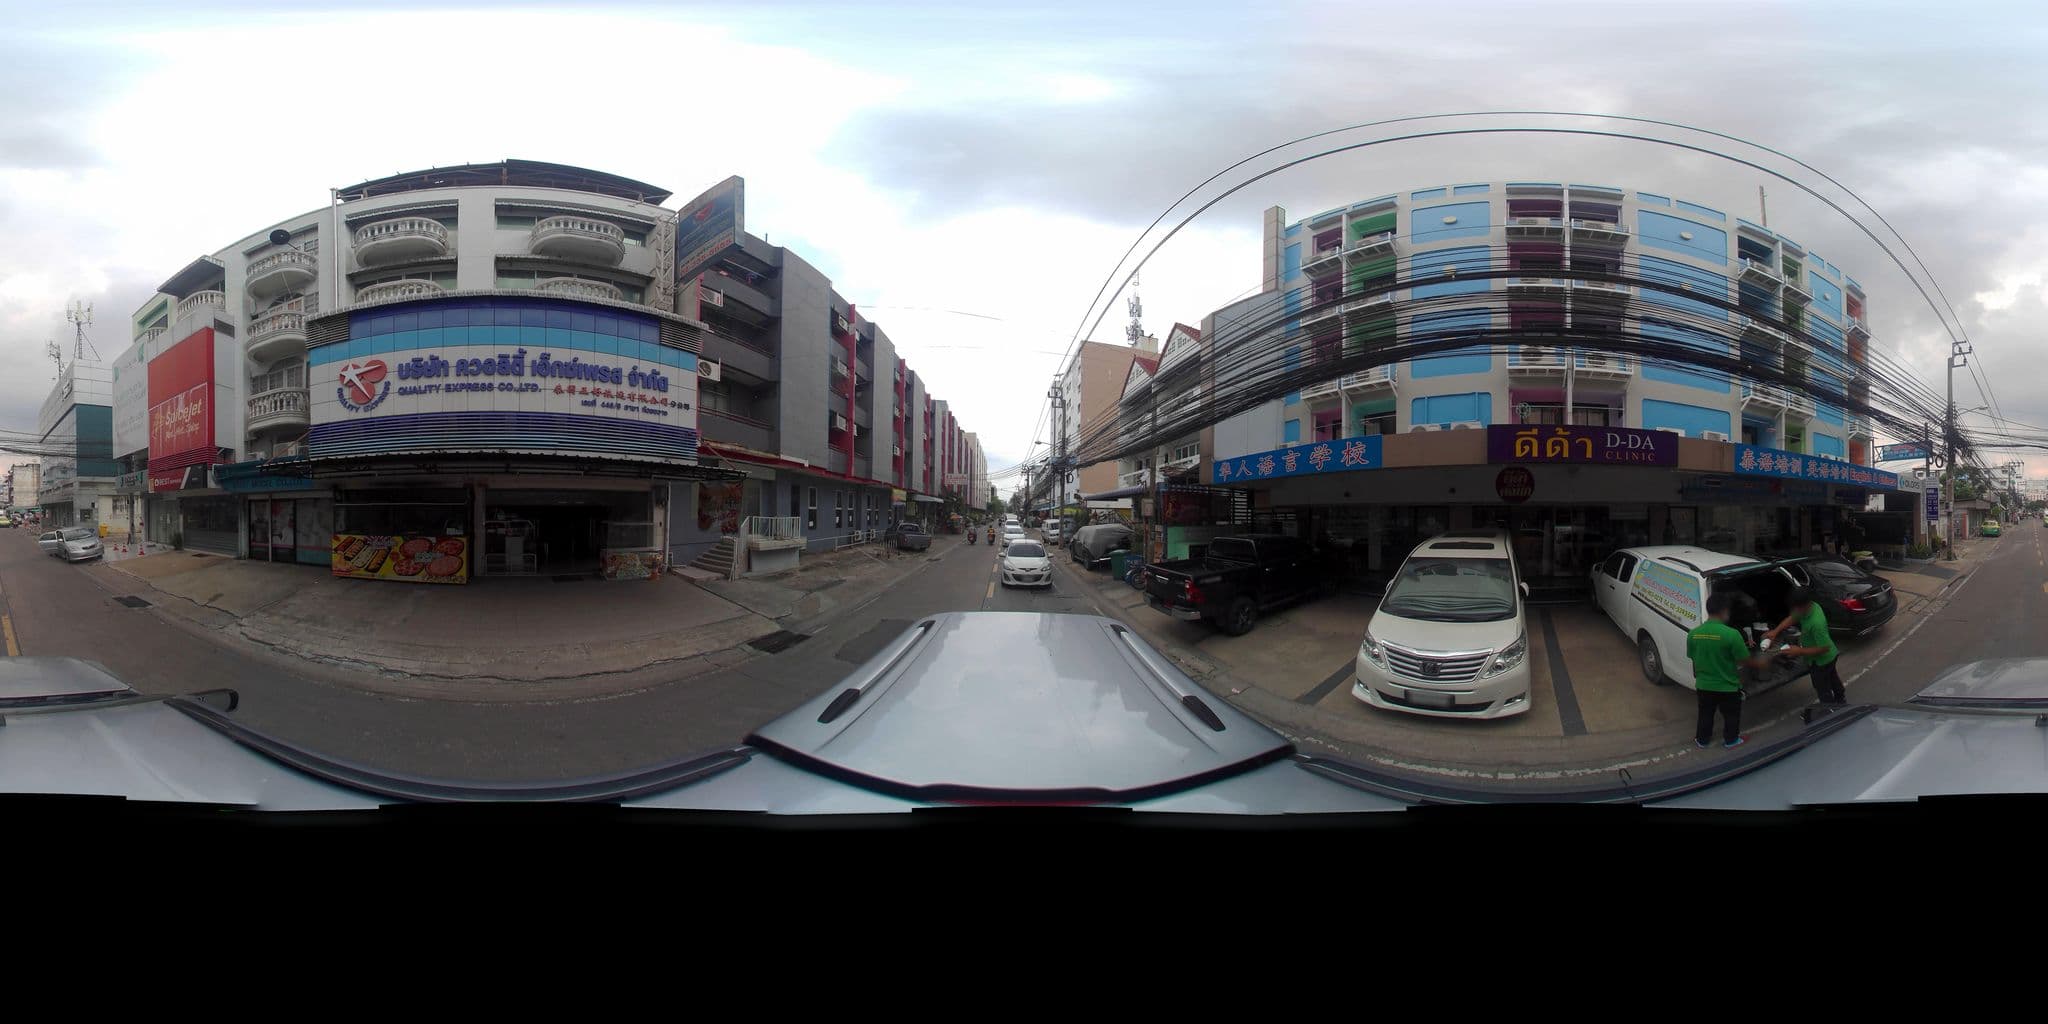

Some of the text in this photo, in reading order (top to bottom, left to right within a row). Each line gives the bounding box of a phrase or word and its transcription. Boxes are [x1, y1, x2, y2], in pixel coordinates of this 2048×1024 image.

[398, 354, 449, 380] บริษัท
[628, 365, 669, 393] จำกัด
[398, 384, 441, 396] QUALITY
[445, 382, 494, 393] EXPRESS
[1515, 427, 1593, 460] ดีด้า
[1606, 432, 1656, 450] D-DA
[1605, 450, 1656, 462] CLINIC
